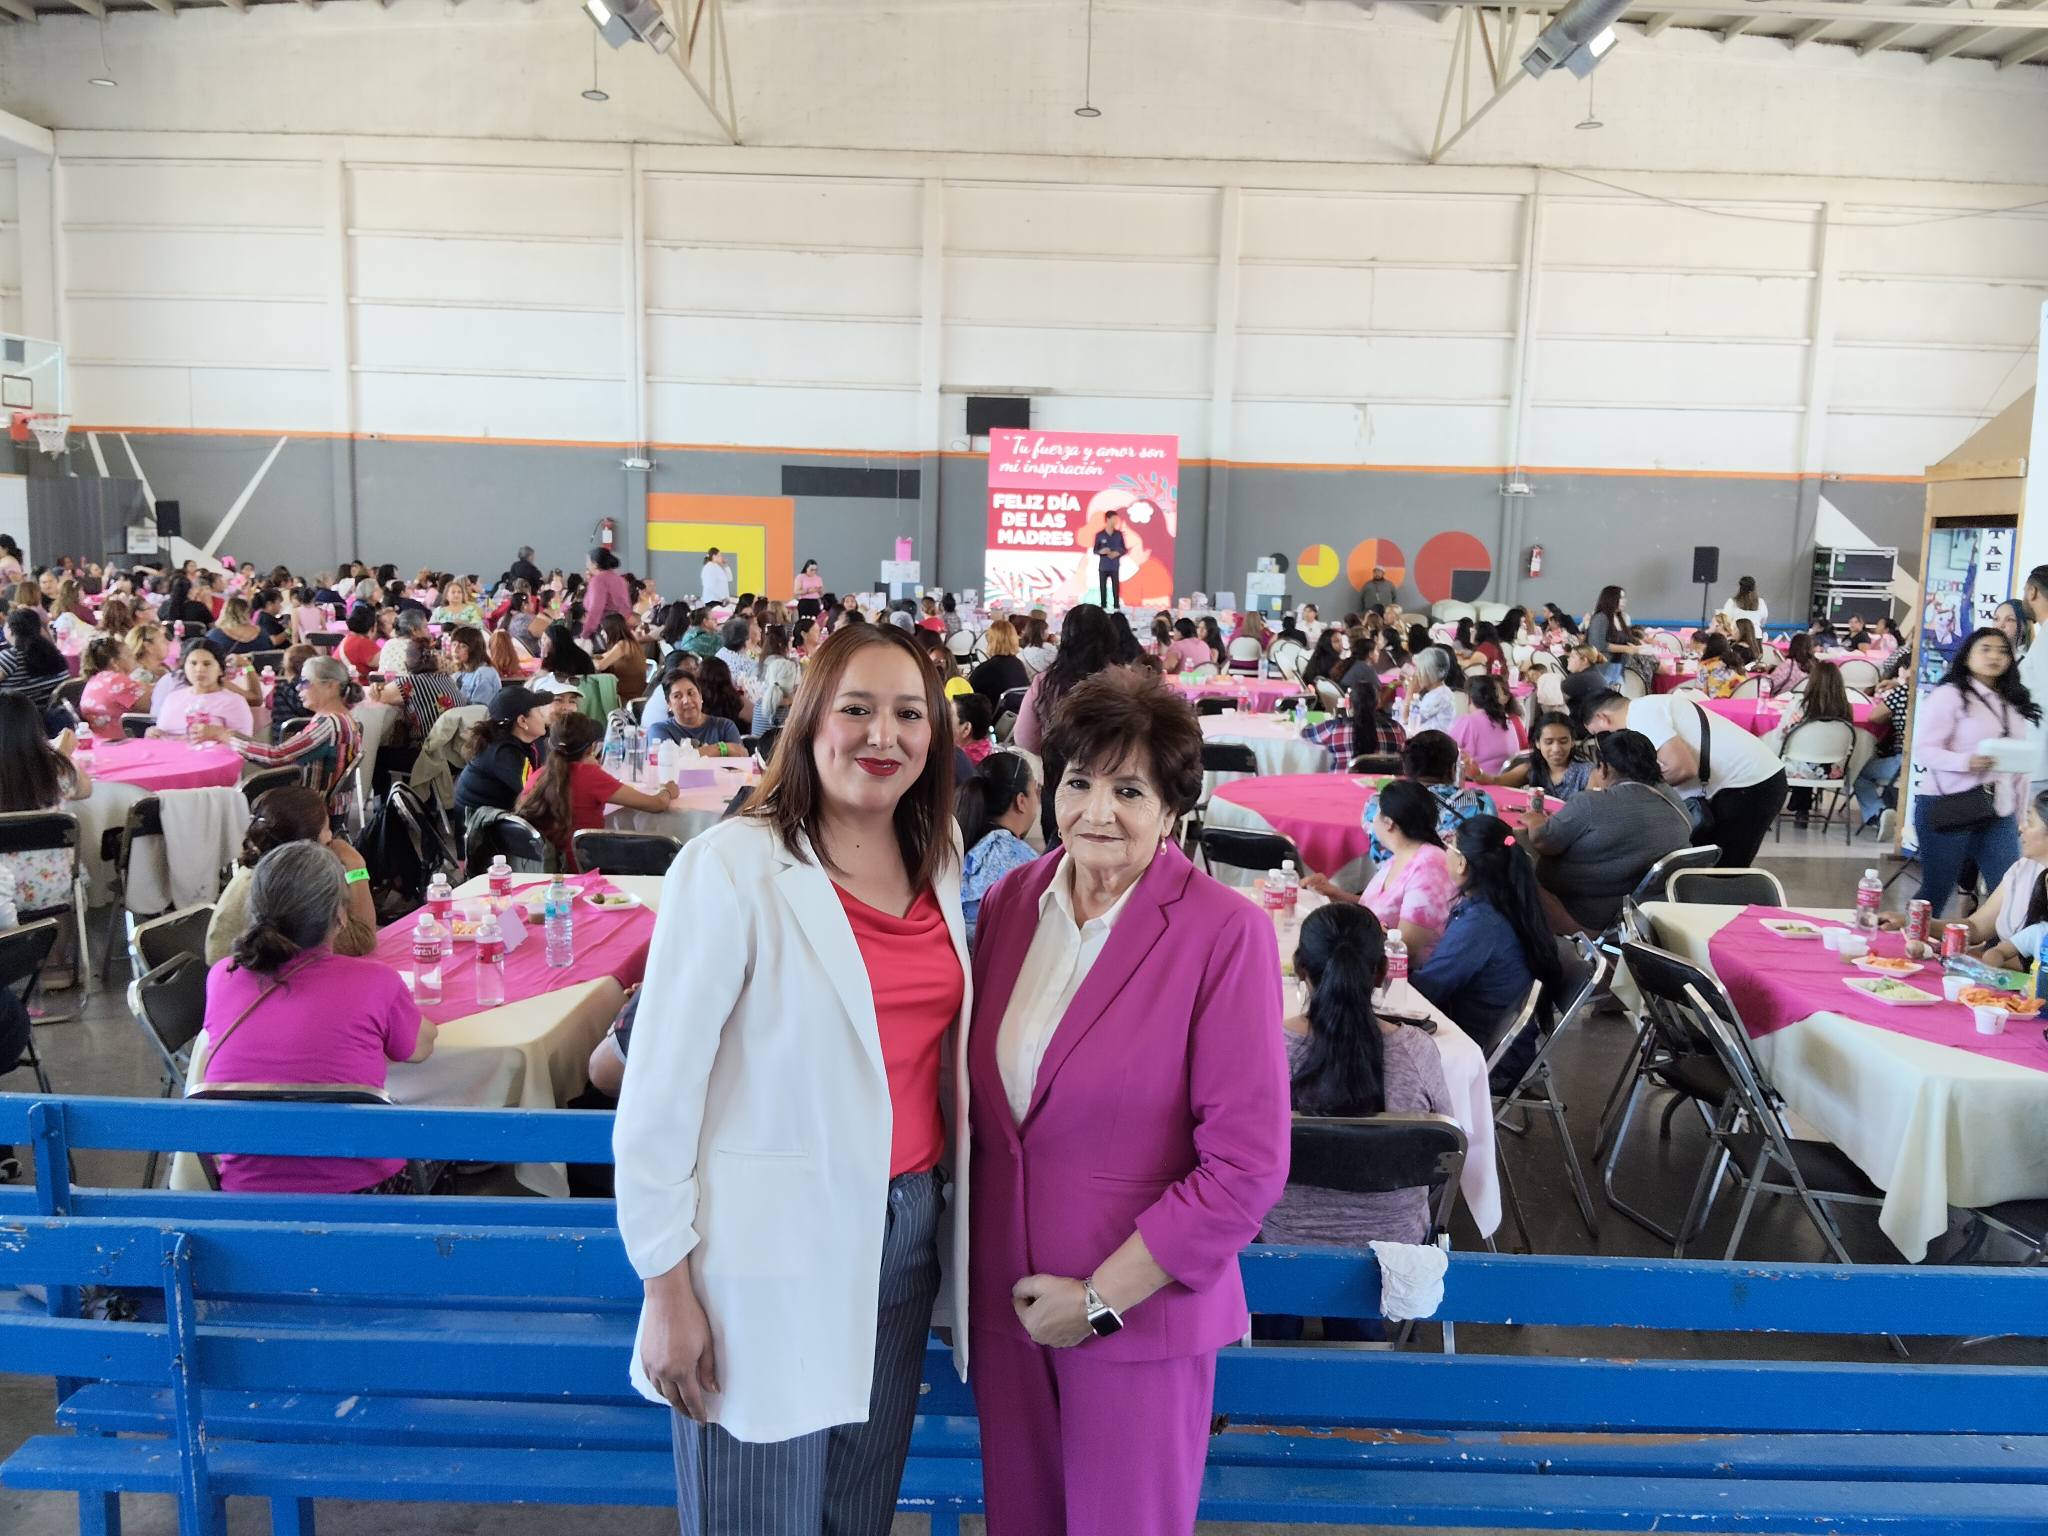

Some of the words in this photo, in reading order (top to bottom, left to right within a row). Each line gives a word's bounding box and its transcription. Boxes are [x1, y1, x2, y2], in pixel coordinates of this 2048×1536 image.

[1032, 436, 1080, 461] fuerza
[1084, 447, 1094, 462] y
[1097, 446, 1136, 459] amor
[1139, 447, 1167, 459] son
[999, 459, 1021, 473] mi
[993, 493, 1045, 511] FELIZ
[1047, 492, 1081, 512] DÍA
[1001, 511, 1028, 528] DE
[1029, 512, 1067, 529] LAS
[997, 528, 1075, 547] MADRES
